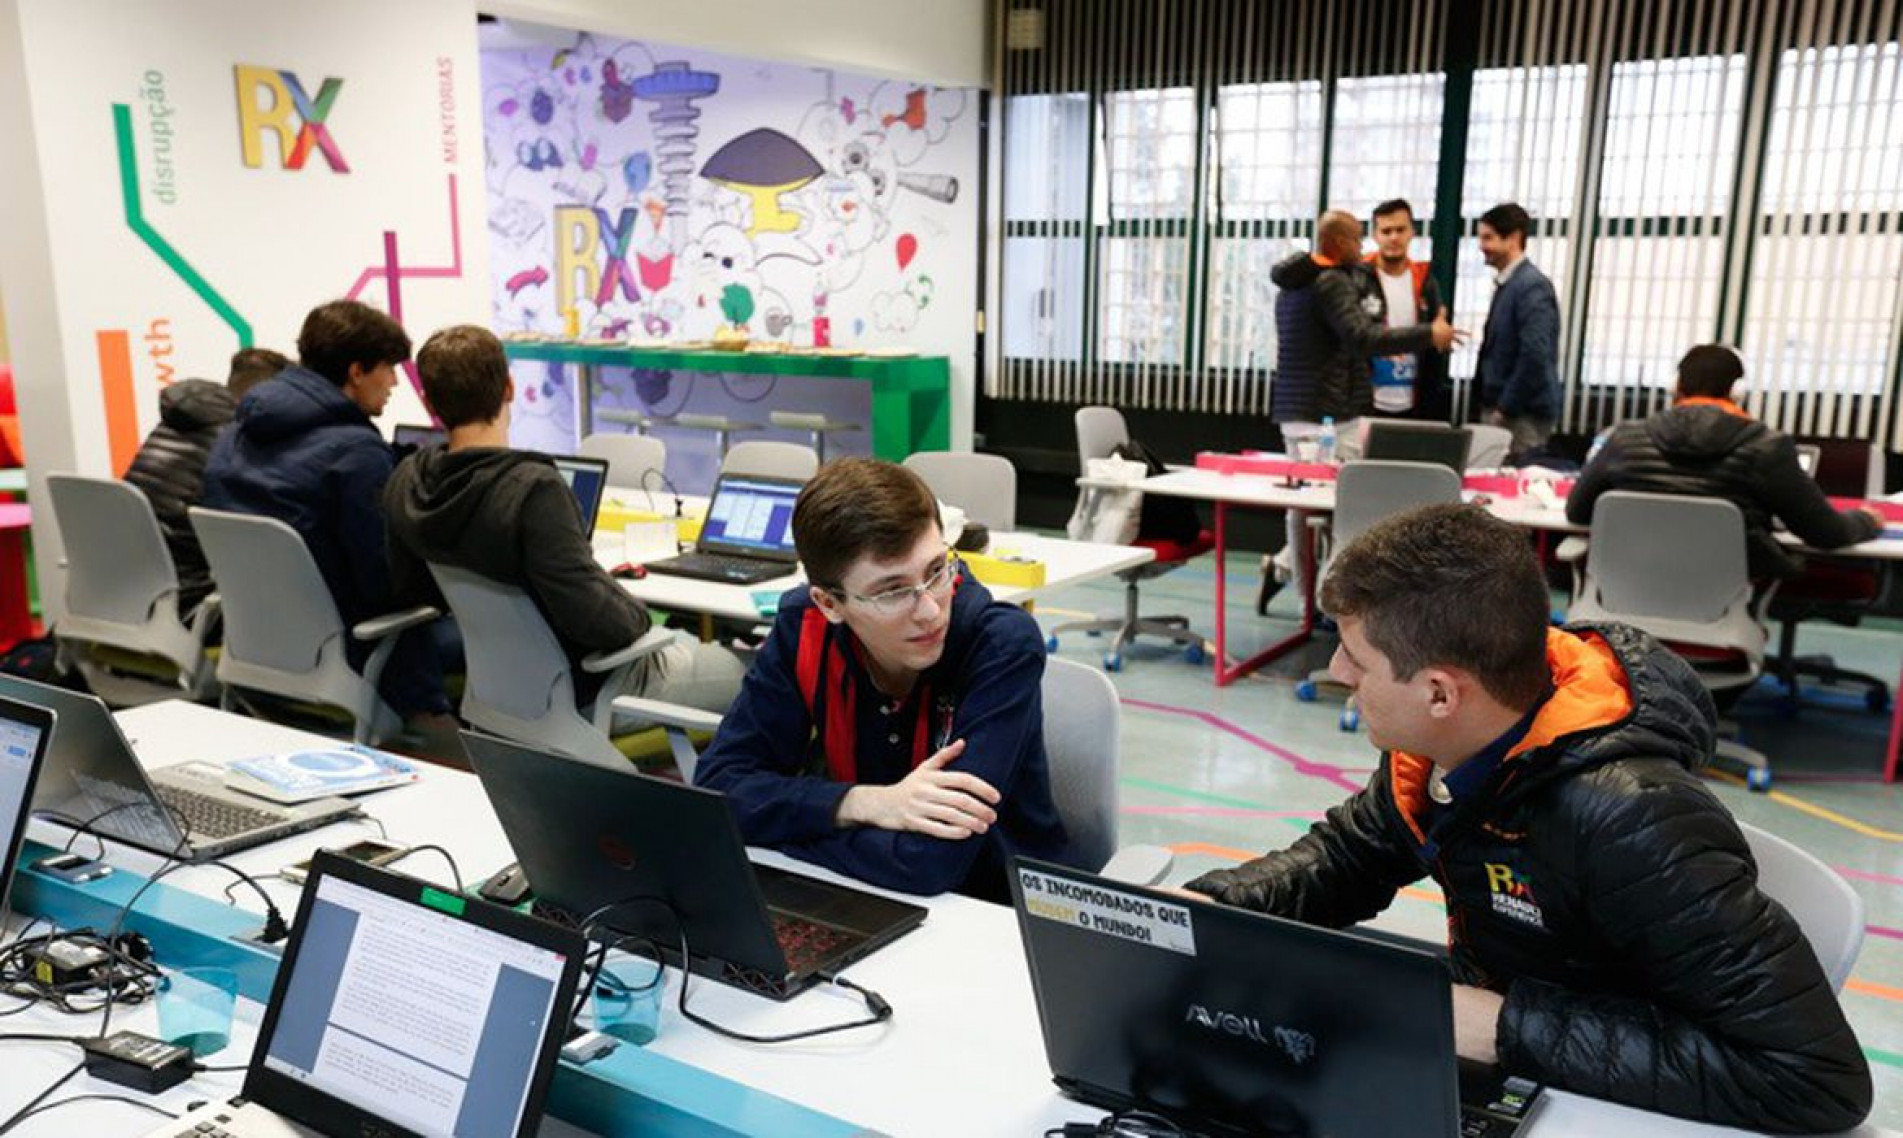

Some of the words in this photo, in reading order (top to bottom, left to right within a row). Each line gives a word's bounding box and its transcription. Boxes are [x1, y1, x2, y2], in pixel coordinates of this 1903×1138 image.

[139, 69, 176, 205] disrupção
[232, 64, 351, 174] RX
[437, 57, 456, 163] MENTORIAS
[553, 204, 641, 318] RX
[1022, 872, 1042, 891] OS
[1158, 906, 1188, 928] QUE
[1079, 911, 1090, 926] O
